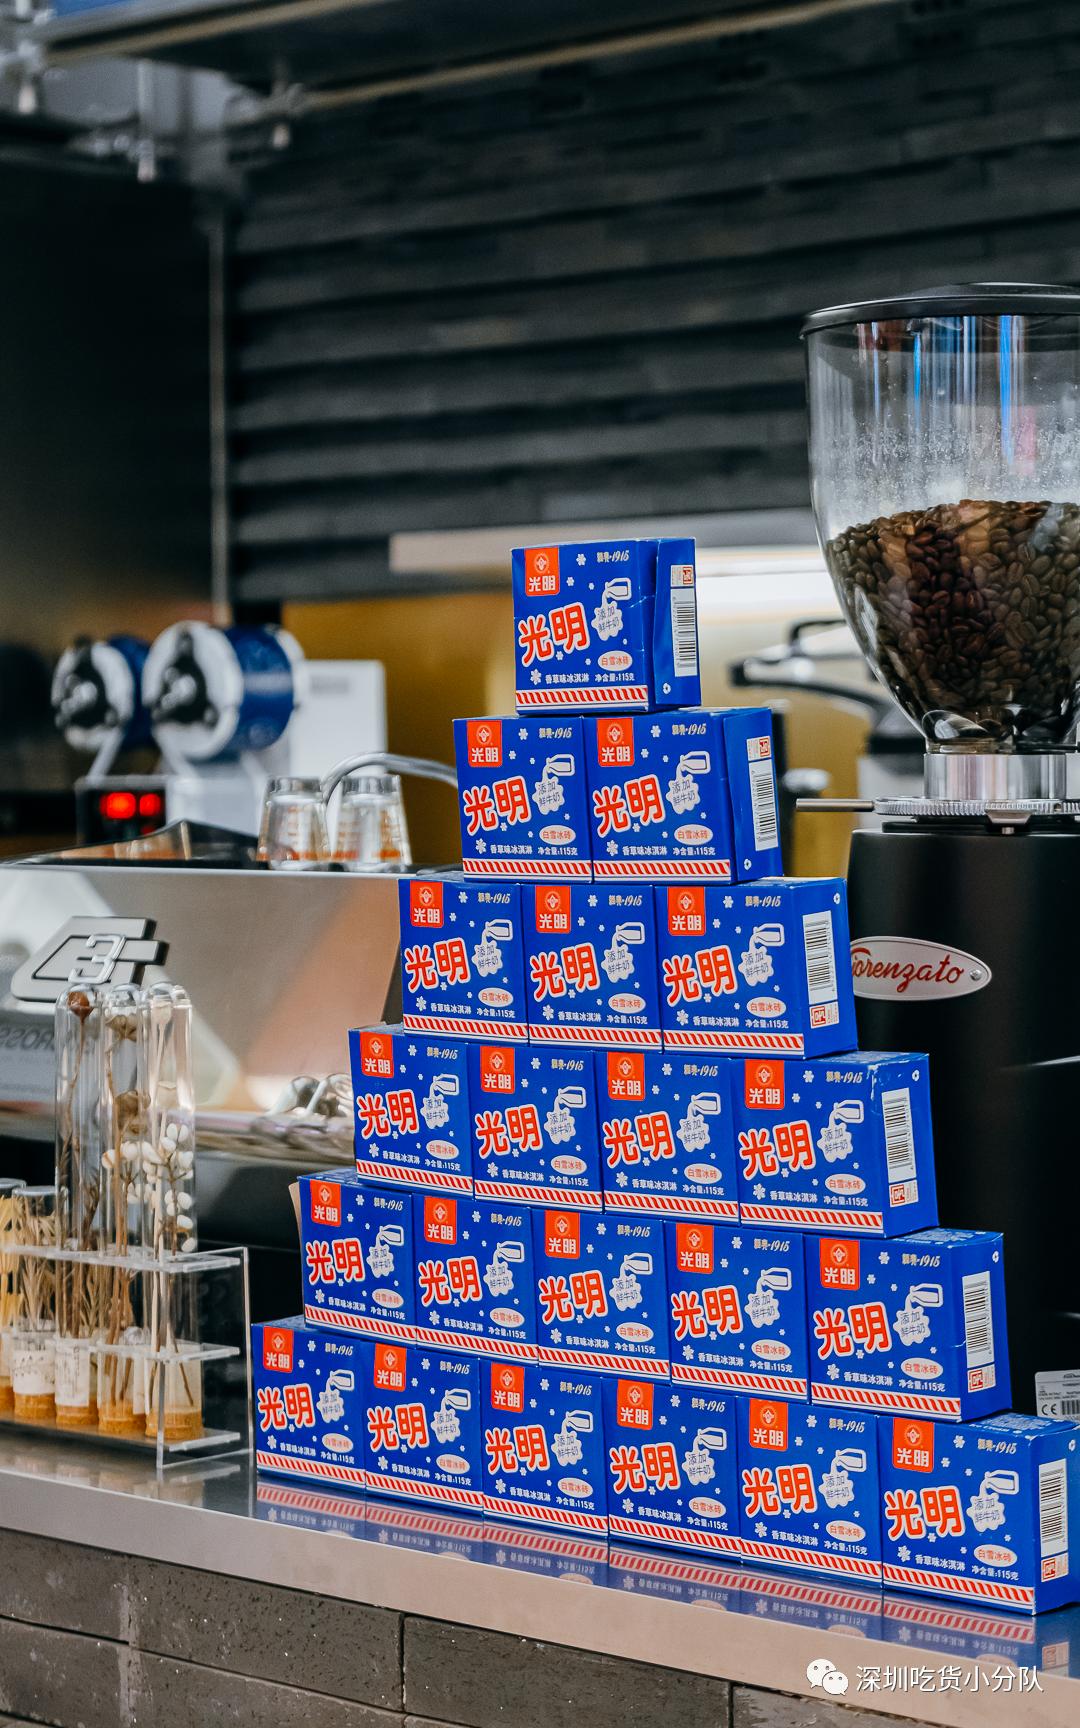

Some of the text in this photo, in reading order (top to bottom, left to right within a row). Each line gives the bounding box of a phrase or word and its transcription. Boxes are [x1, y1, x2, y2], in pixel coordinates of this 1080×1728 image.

[527, 574, 556, 592] 光明
[518, 603, 587, 664] 光明
[600, 655, 632, 666] 白雪冰砖
[544, 672, 590, 684] 香草味冰淇淋
[471, 746, 498, 762] 光明
[601, 745, 630, 762] 光明
[462, 777, 530, 834] 光明
[593, 775, 663, 835] 光明
[676, 829, 708, 840] 白雪冰砖
[621, 845, 667, 855] 香草味冰淇淋
[413, 907, 440, 923] 光明
[539, 913, 567, 929] 光明
[671, 914, 701, 931] 光明
[404, 938, 469, 991] 光明
[530, 944, 598, 1000] 光明
[662, 946, 736, 1004] 光明
[611, 998, 641, 1009] 白雪冰砖
[749, 1002, 782, 1013] 白雪冰砖
[557, 1010, 602, 1022] 香草味冰淇淋
[692, 1015, 739, 1027] 香草味冰淇淋
[365, 1056, 391, 1074] 光明
[484, 1072, 511, 1089] 光明
[611, 1079, 641, 1096] 光明
[749, 1087, 780, 1104] 光明
[358, 1090, 418, 1137] 光明
[475, 1105, 541, 1157] 光明
[602, 1112, 674, 1166] 光明
[739, 1121, 814, 1178] 光明
[686, 1167, 718, 1179] 白雪冰砖
[631, 1178, 677, 1191] 香草味冰淇淋
[828, 1178, 861, 1190] 白雪冰砖
[769, 1190, 818, 1202] 香草味冰淇淋
[313, 1204, 338, 1222] 光明
[427, 1223, 453, 1240] 光明
[548, 1237, 576, 1254] 光明
[305, 1239, 364, 1283] 光明
[680, 1251, 709, 1269] 光明
[418, 1257, 481, 1305] 光明
[823, 1267, 855, 1285] 光明
[538, 1271, 607, 1322] 光明
[670, 1286, 741, 1339] 光明
[619, 1326, 649, 1339] 白雪冰砖
[813, 1303, 890, 1357] 光明
[565, 1335, 609, 1349] 香草味冰淇淋
[754, 1343, 786, 1357] 白雪冰砖
[265, 1351, 289, 1368] 光明
[697, 1351, 744, 1366] 香草味冰淇淋
[904, 1362, 938, 1375] 白雪冰砖
[376, 1369, 402, 1387] 光明
[843, 1370, 893, 1386] 香草味冰淇淋
[257, 1384, 315, 1430] 光明
[493, 1389, 520, 1408] 光明
[620, 1406, 649, 1425] 光明
[367, 1403, 428, 1450] 光明
[753, 1427, 783, 1446] 光明
[484, 1425, 549, 1473] 光明
[896, 1447, 929, 1467] 光明
[610, 1443, 679, 1492] 光明
[742, 1465, 816, 1515] 光明
[637, 1505, 681, 1522] 香草味冰淇淋
[691, 1500, 722, 1515] 白雪冰砖
[885, 1487, 963, 1538] 光明
[770, 1529, 818, 1546] 香草味冰淇淋
[828, 1523, 861, 1538] 白雪冰砖
[914, 1553, 965, 1571] 香草味冰淇淋
[976, 1548, 1012, 1563] 白雪冰砖
